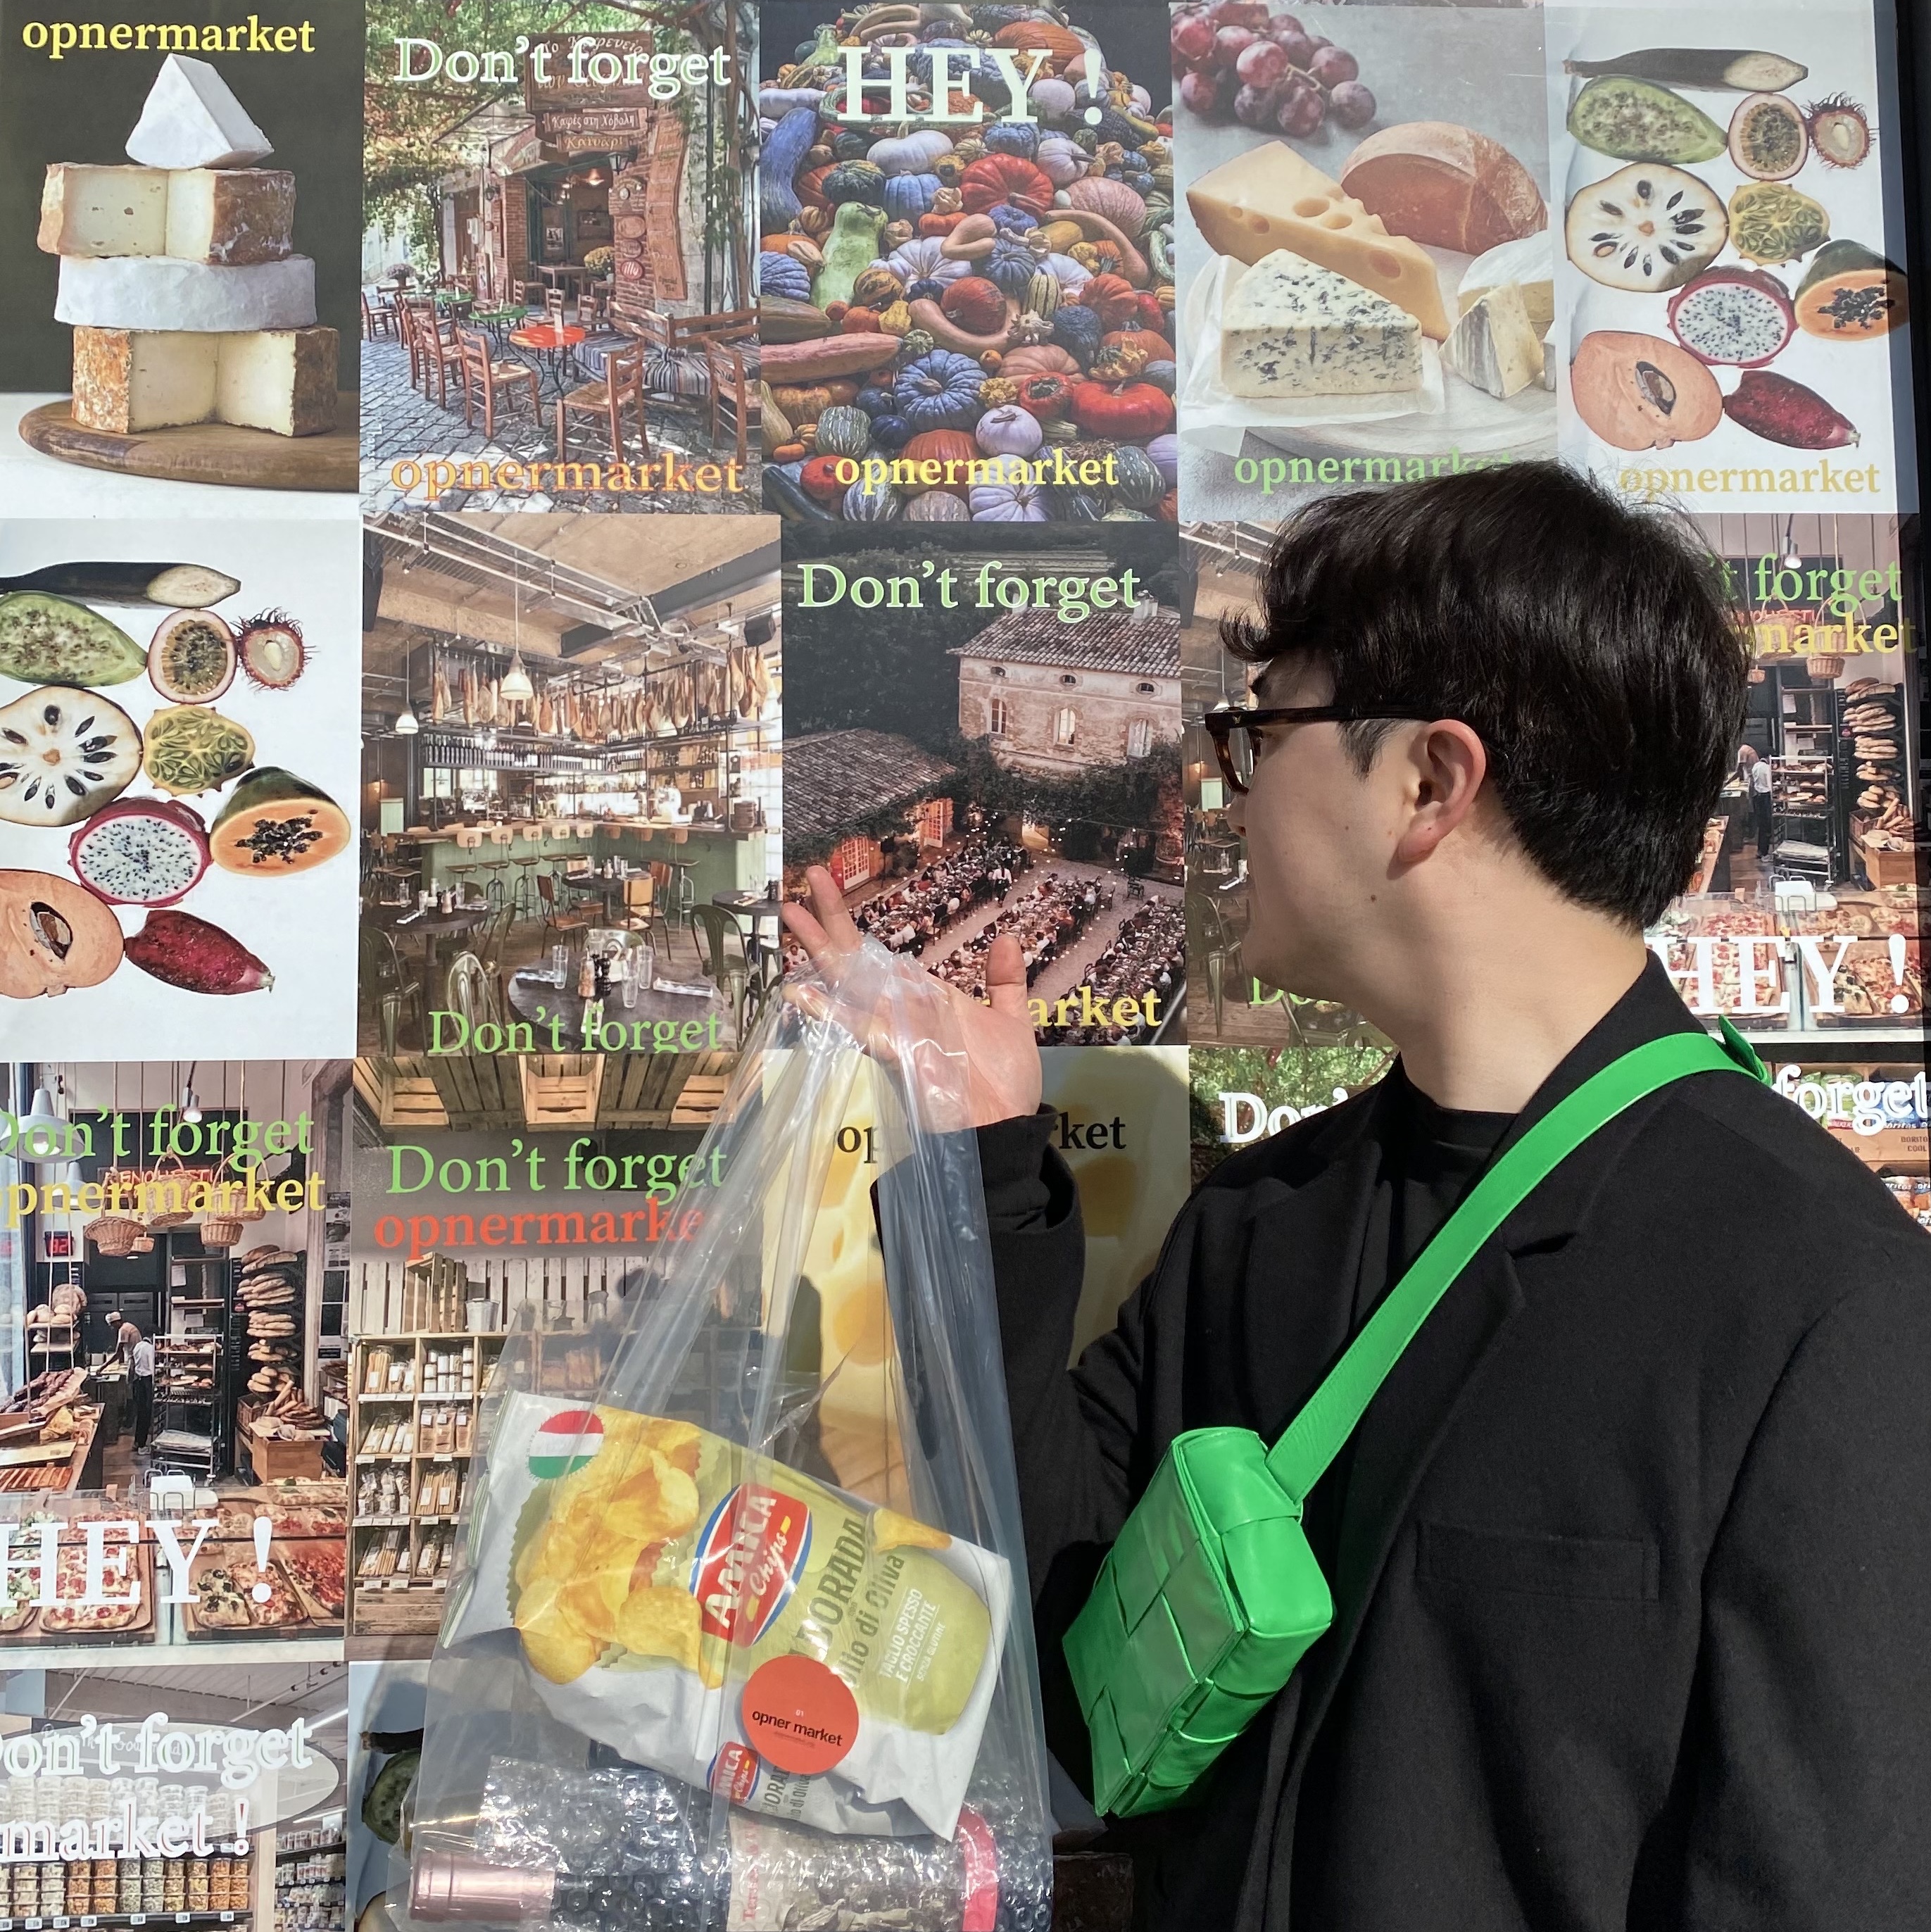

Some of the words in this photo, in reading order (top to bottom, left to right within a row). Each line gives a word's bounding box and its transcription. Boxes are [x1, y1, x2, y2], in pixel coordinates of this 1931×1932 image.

[23, 14, 315, 59] opnermarket
[394, 35, 553, 83] Don't
[567, 36, 732, 100] forget
[836, 46, 1053, 125] HEY
[391, 449, 744, 502] opnermarket
[835, 448, 1119, 496] opnermarket
[1620, 458, 1881, 506] opnermarket
[797, 560, 959, 608] Don't
[975, 560, 1141, 624] forget
[1754, 553, 1904, 617] forget
[1644, 934, 1858, 1015] HEY
[427, 1005, 566, 1054] Don't
[581, 1005, 723, 1055] forget
[1772, 1064, 1929, 1136] forget
[149, 1103, 315, 1173] forget
[1, 1167, 327, 1229] pnermarket
[386, 1138, 546, 1195] Don't
[563, 1136, 728, 1207] forget
[374, 1196, 705, 1261] opnermarke
[704, 1496, 777, 1630] AMICA
[750, 1531, 788, 1597] Chips
[895, 1588, 924, 1636] SPESSO
[899, 1599, 937, 1673] CROCCANTE
[134, 1711, 313, 1790] forget
[752, 1710, 792, 1730] opner
[793, 1723, 843, 1747] market
